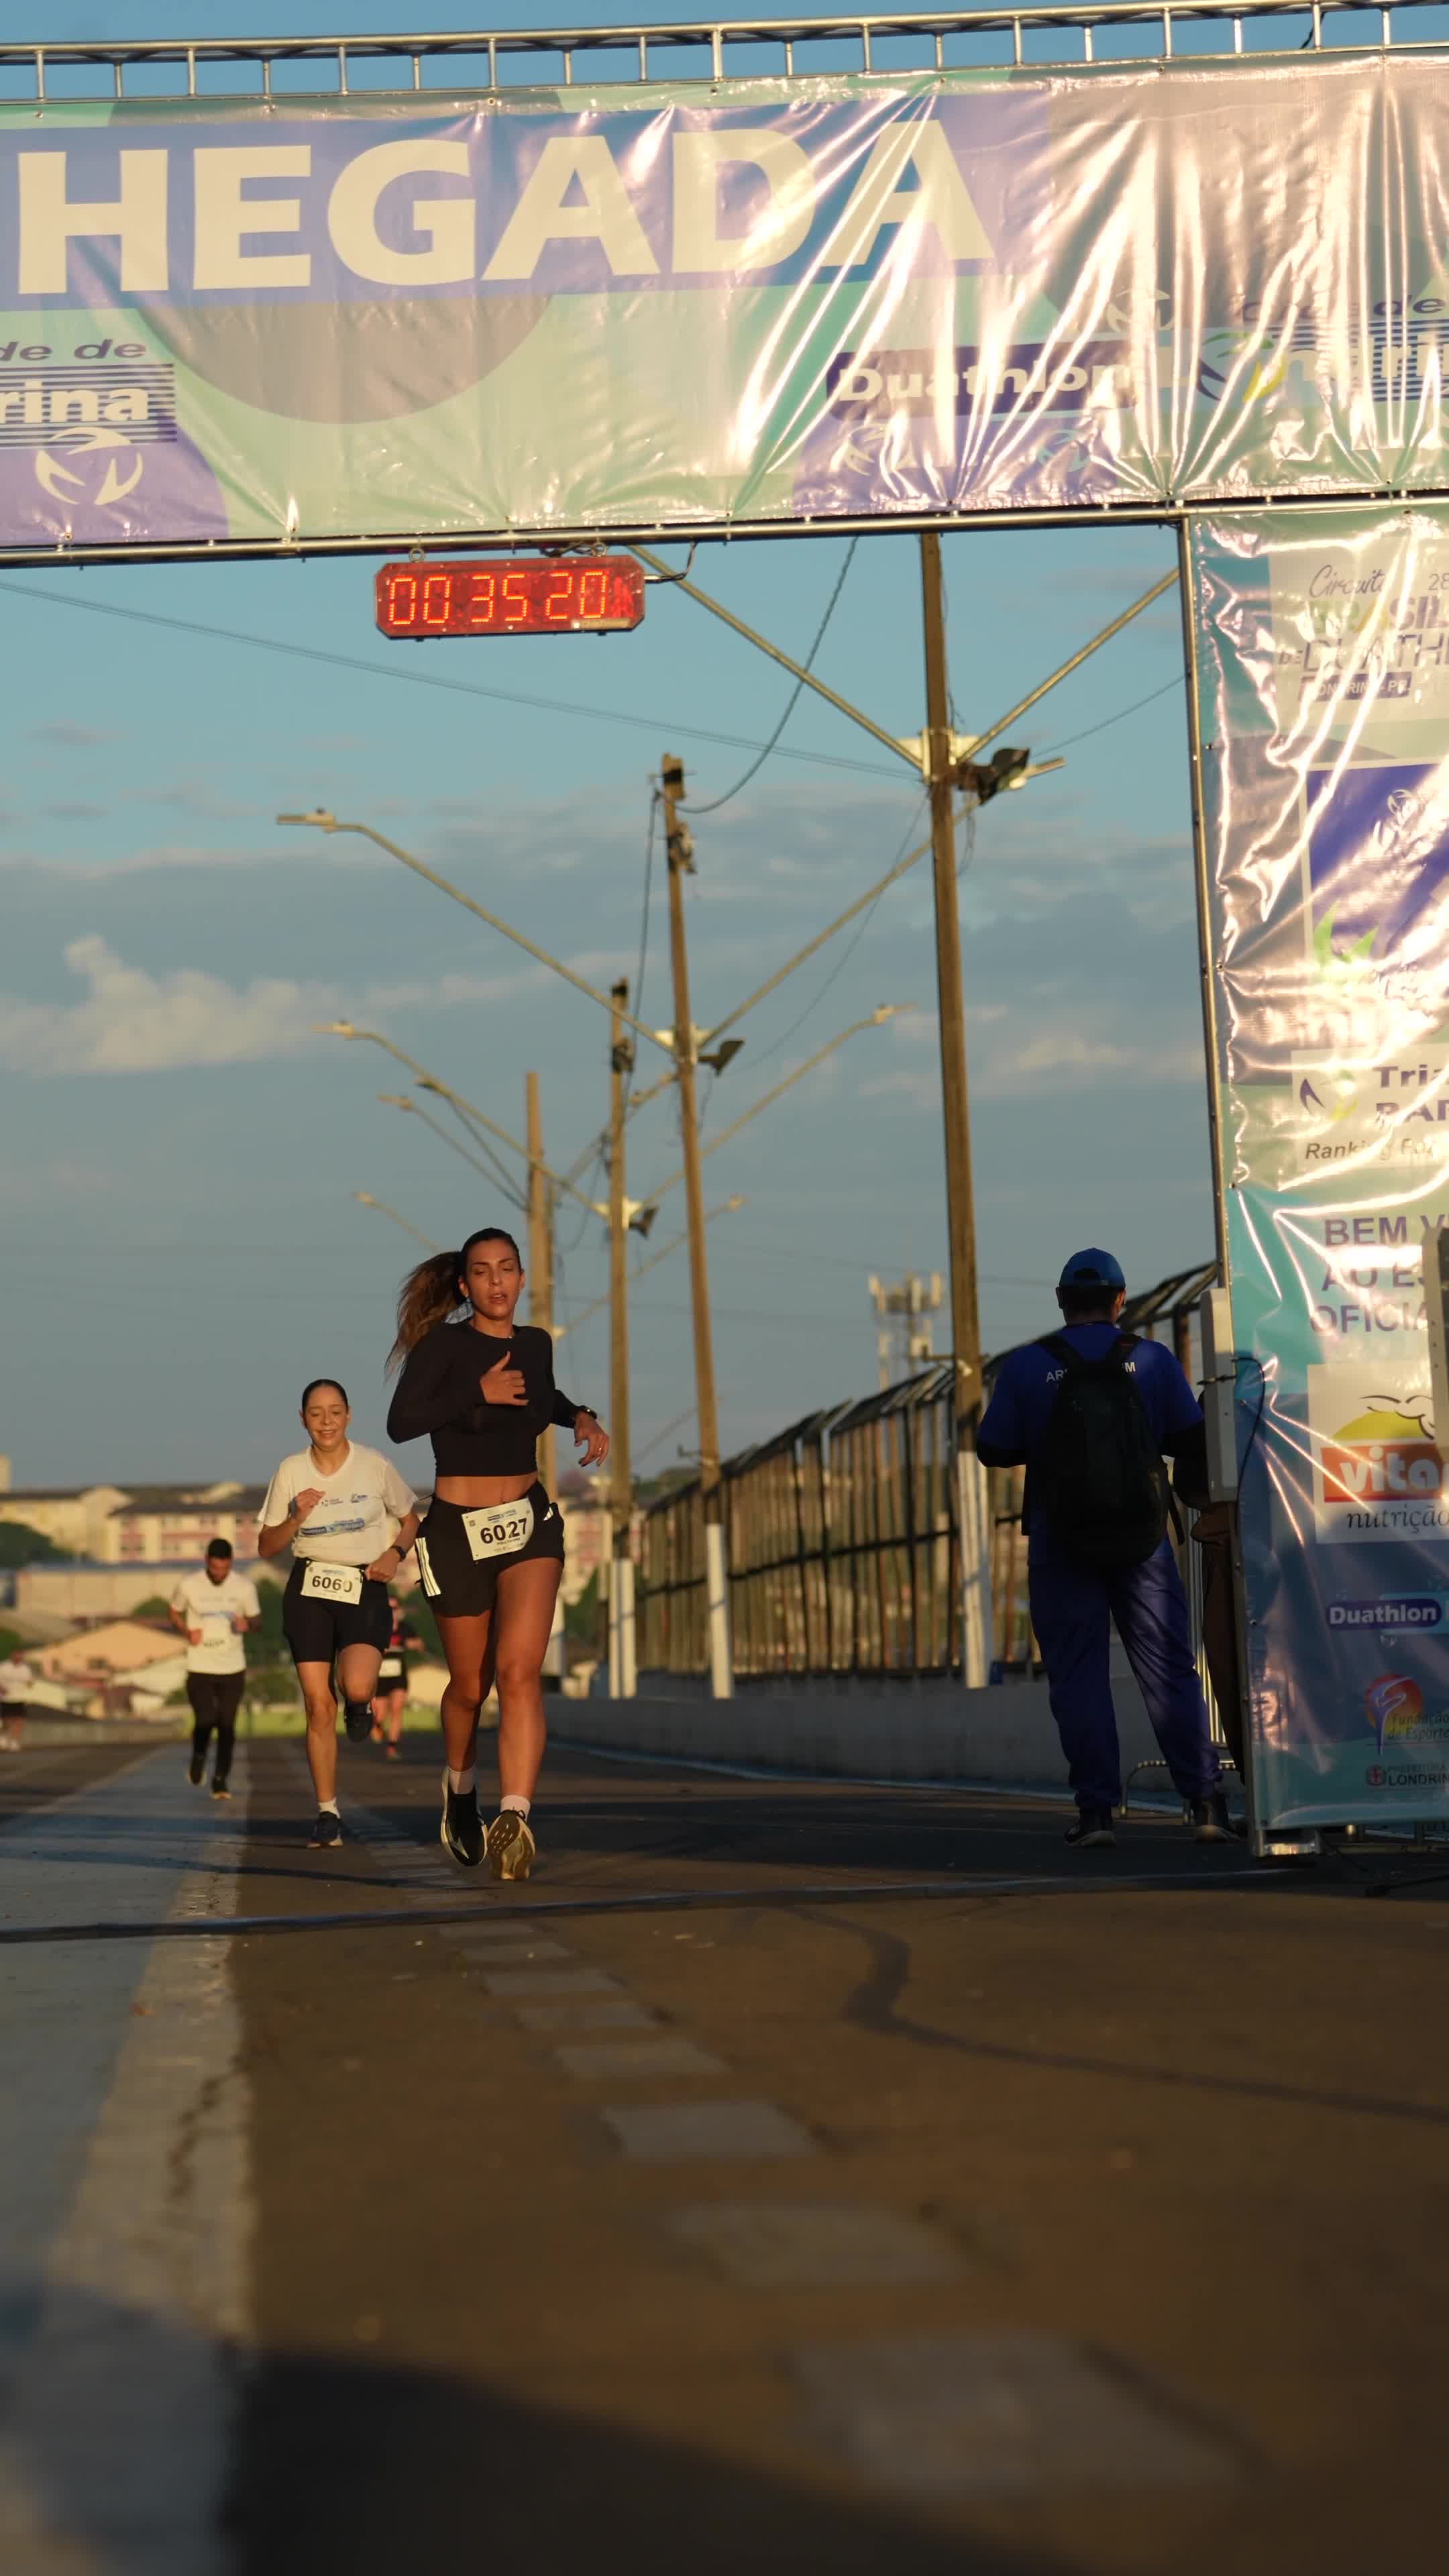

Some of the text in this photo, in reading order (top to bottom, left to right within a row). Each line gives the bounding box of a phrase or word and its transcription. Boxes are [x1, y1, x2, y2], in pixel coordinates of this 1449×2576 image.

[18, 119, 996, 294] HEGADA
[74, 339, 147, 360] de
[0, 380, 148, 424] rina
[1324, 1216, 1408, 1246] BEM
[480, 1517, 527, 1544] 6027
[1330, 1604, 1437, 1624] Duathlon
